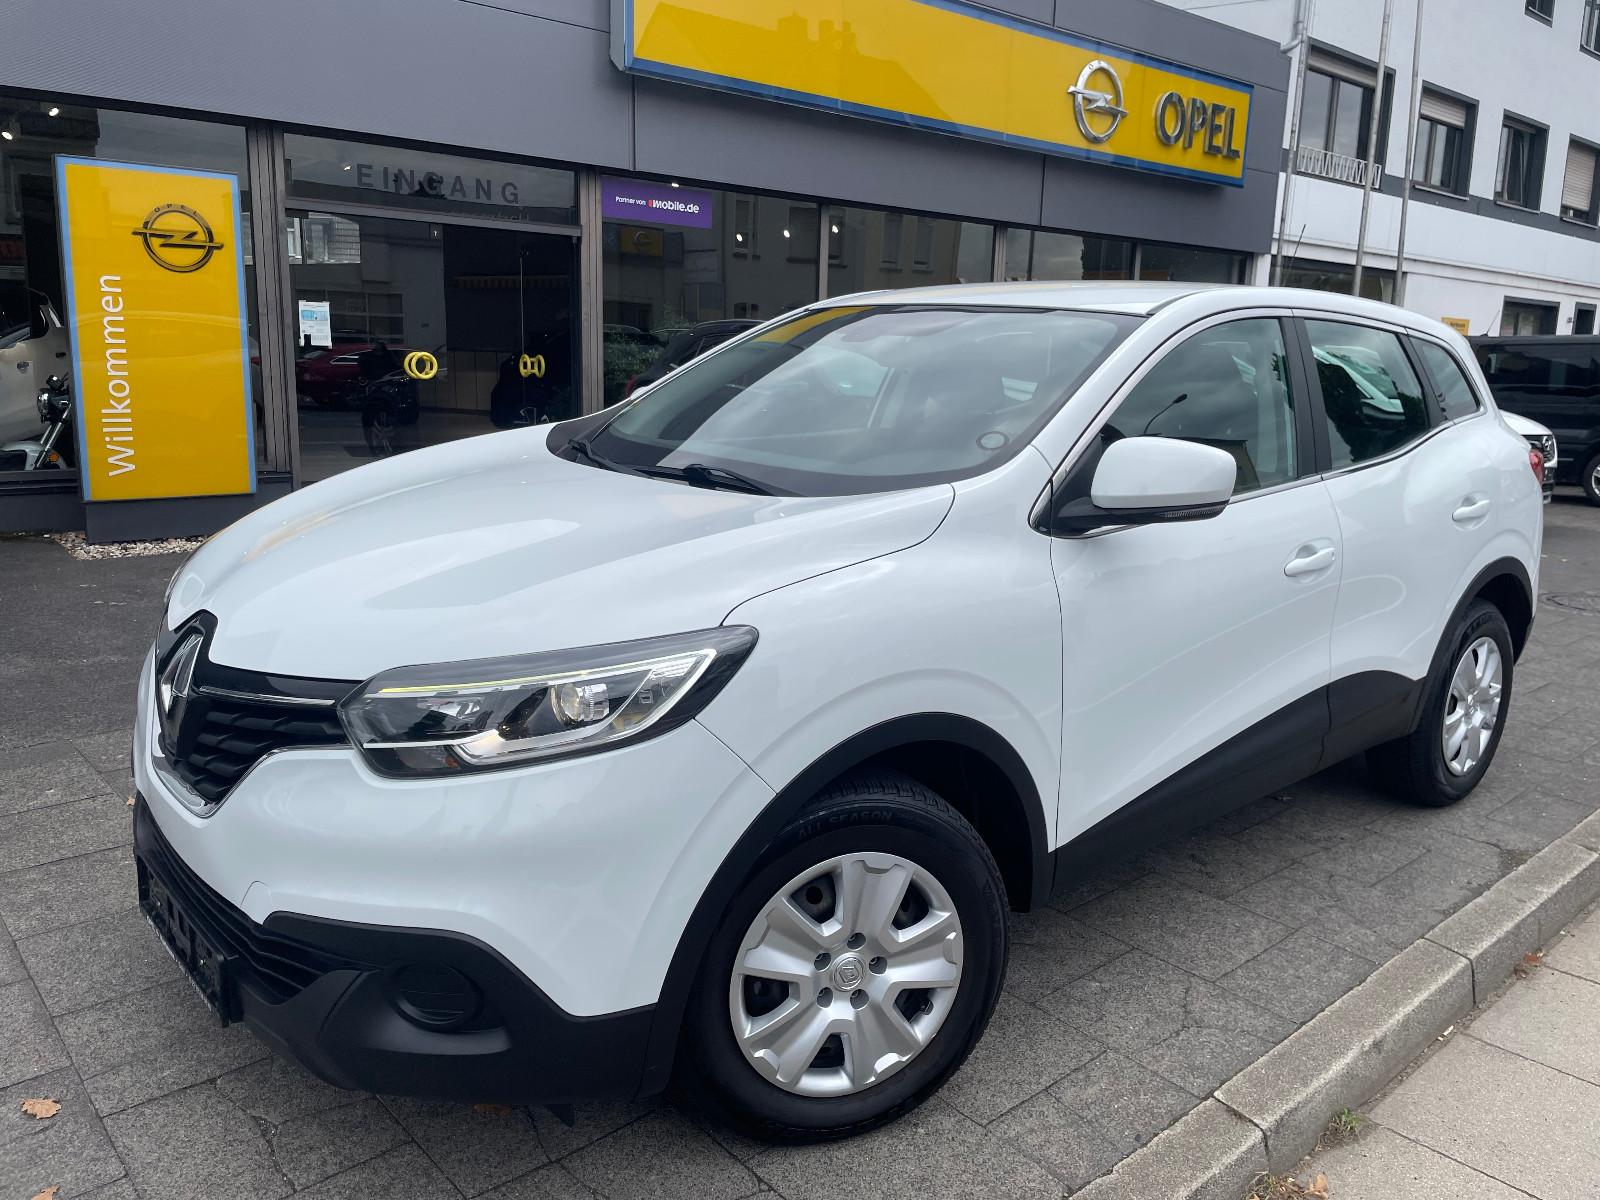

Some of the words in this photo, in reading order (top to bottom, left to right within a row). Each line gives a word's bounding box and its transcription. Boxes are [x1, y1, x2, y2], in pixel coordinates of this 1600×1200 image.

[1156, 90, 1241, 160] OPEL
[153, 203, 198, 215] OPEL
[356, 163, 520, 205] EINGANG
[99, 274, 136, 477] Willkommen
